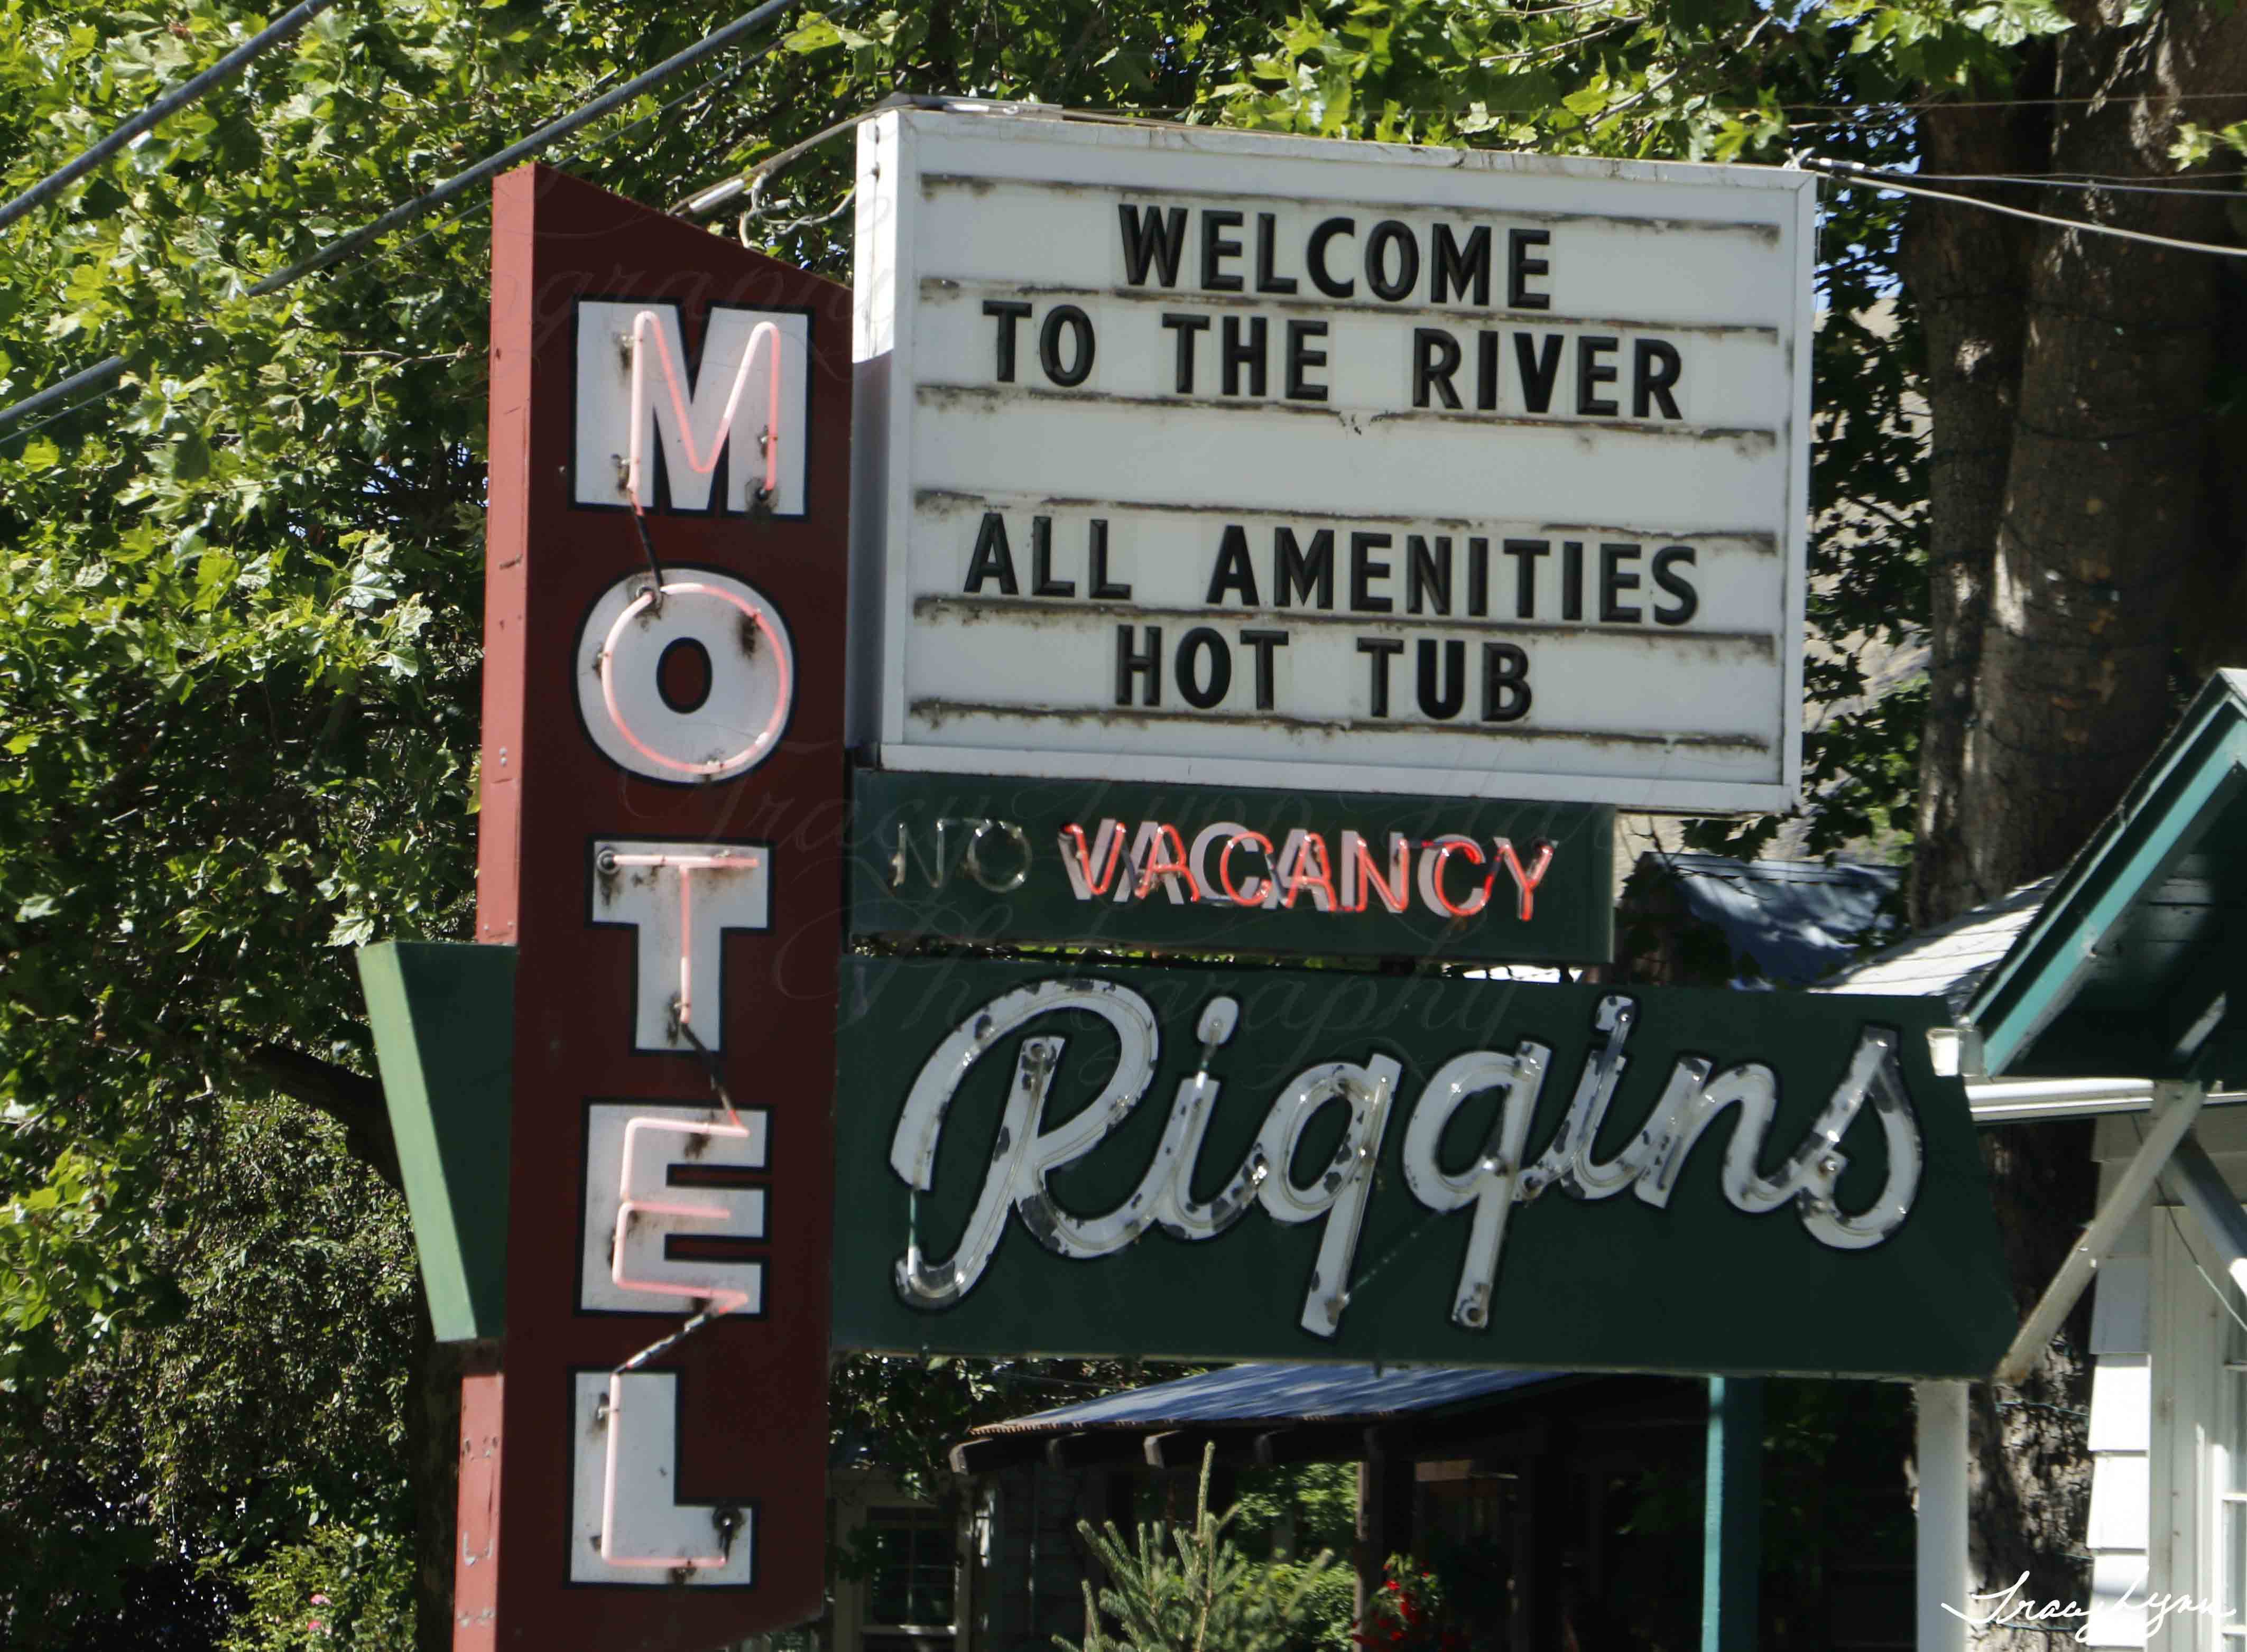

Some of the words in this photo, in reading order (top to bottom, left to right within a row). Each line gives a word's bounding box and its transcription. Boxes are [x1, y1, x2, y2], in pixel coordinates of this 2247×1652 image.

[1117, 203, 1551, 311] WELCOME
[982, 299, 1096, 388] TO
[1161, 312, 1329, 405] THE
[1412, 327, 1683, 421] RIVER
[963, 511, 1132, 601] ALL
[1205, 524, 1699, 627] AMENITIES
[1114, 623, 1290, 711] HOT
[1356, 636, 1533, 723] TUB
[891, 818, 1033, 893] NO
[1058, 817, 1558, 921] VACANCY
[571, 302, 807, 1585] MOTEL
